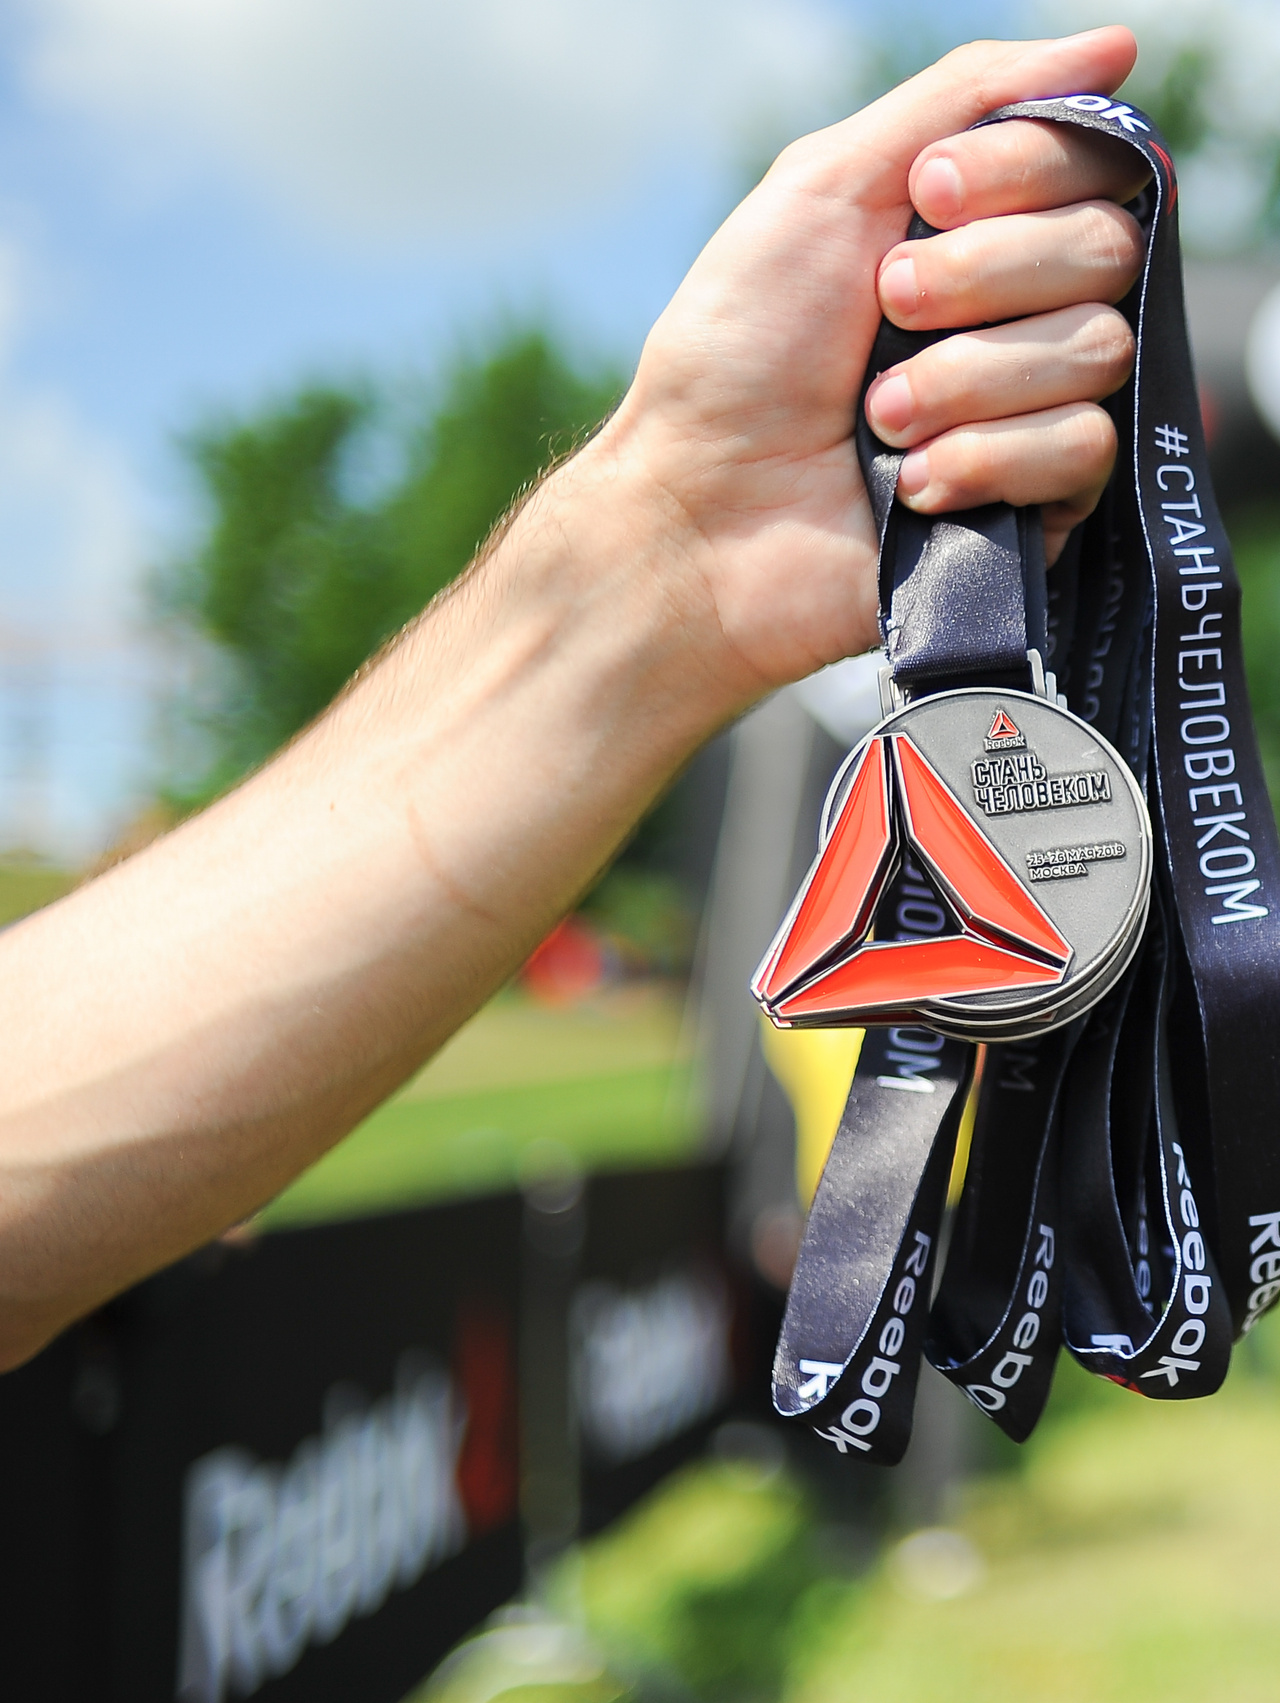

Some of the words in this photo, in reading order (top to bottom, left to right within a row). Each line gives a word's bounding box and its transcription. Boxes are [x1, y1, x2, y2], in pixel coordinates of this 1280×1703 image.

[1153, 424, 1269, 926] #СТАНЬЧЕЛОВЕКОМ
[985, 737, 1025, 750] Reebok
[972, 755, 1046, 787] СТАНЬ
[975, 774, 1112, 813] ЧЕЛОВЕКОМ
[1067, 848, 1096, 862] МАЯ
[1098, 844, 1126, 858] 2019
[1030, 862, 1088, 880] МОСКВА
[958, 1223, 1055, 1418] Reebo
[812, 1230, 931, 1453] Reebok
